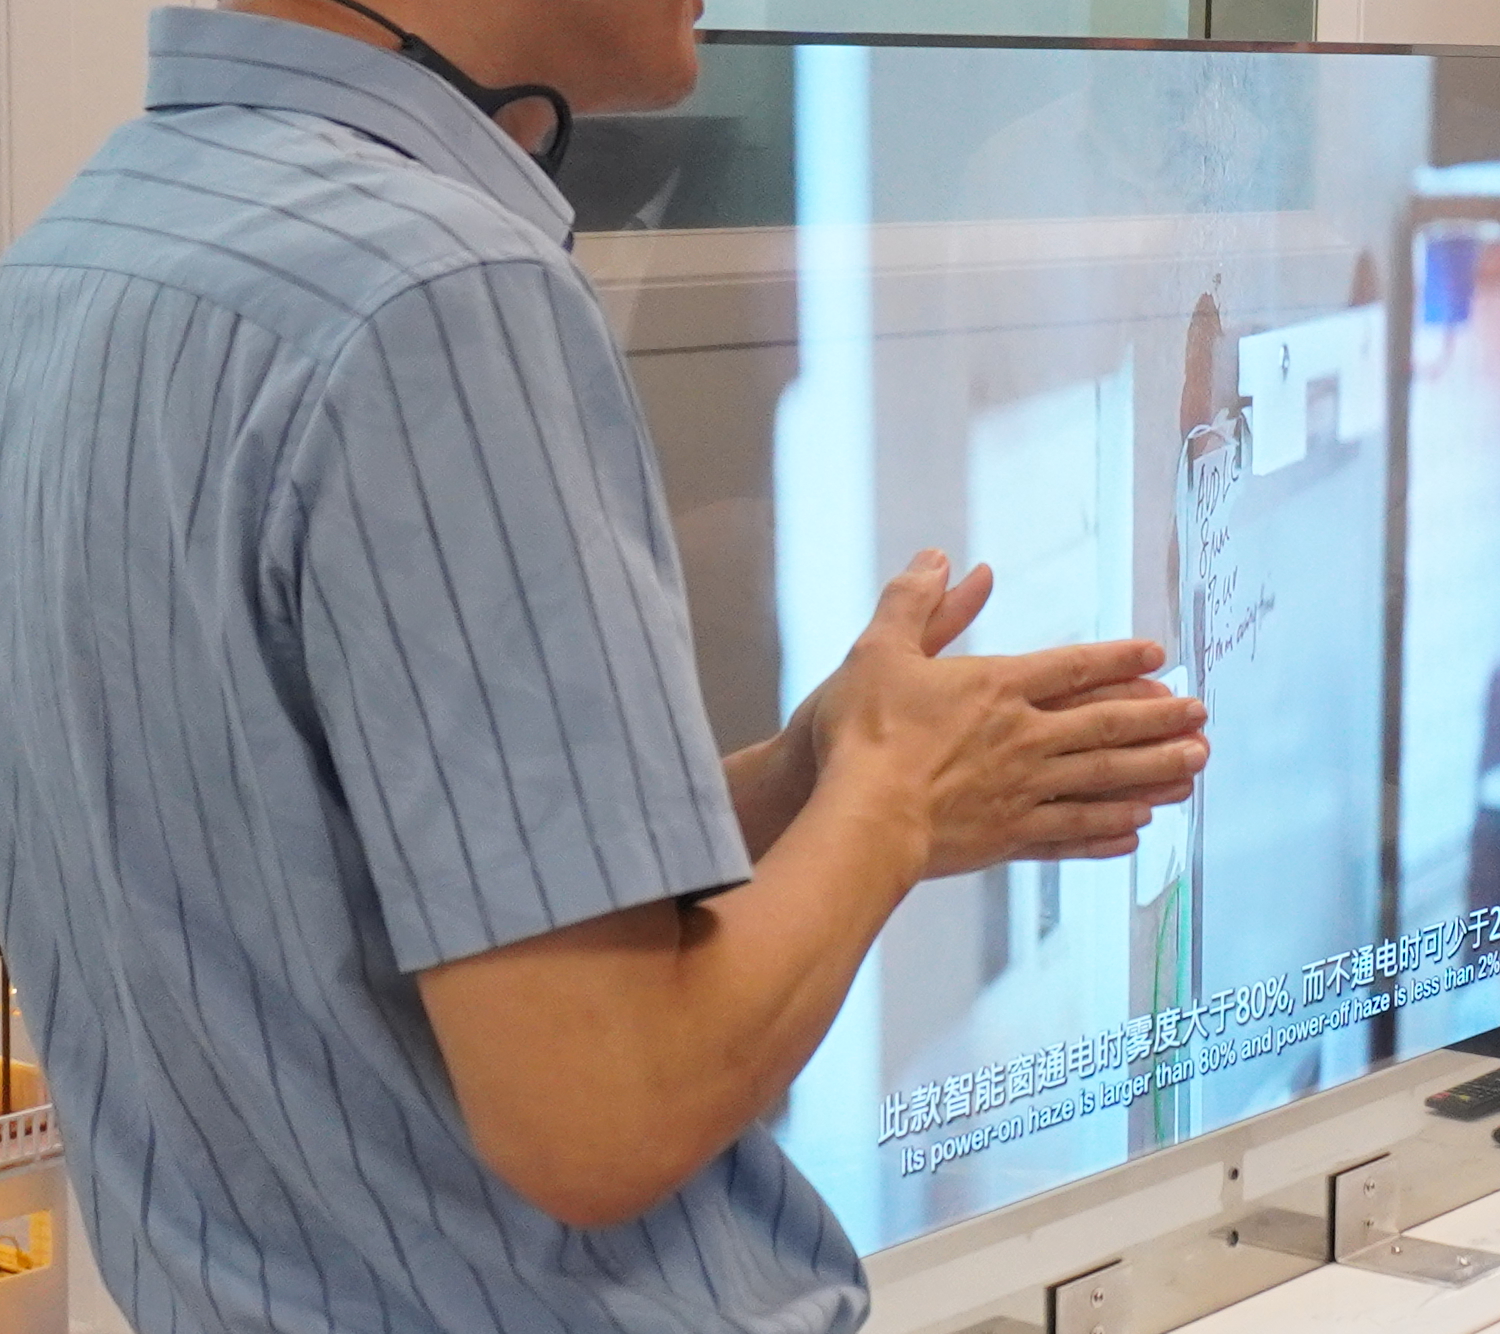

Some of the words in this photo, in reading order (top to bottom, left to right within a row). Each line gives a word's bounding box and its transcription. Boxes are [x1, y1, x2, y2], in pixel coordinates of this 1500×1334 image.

[900, 1145, 926, 1178] Its
[929, 1115, 1024, 1173] power-on
[1026, 1099, 1076, 1135] haze
[1078, 1089, 1096, 1116] is
[1099, 1072, 1152, 1110] larger
[1155, 1058, 1195, 1090] than
[1198, 1039, 1238, 1075] 80%
[1240, 1026, 1274, 1061] and
[1276, 999, 1351, 1056] power-off
[1352, 993, 1391, 1023] haze
[1393, 984, 1408, 1008] is
[1409, 975, 1441, 1004] less
[1443, 961, 1476, 991] than
